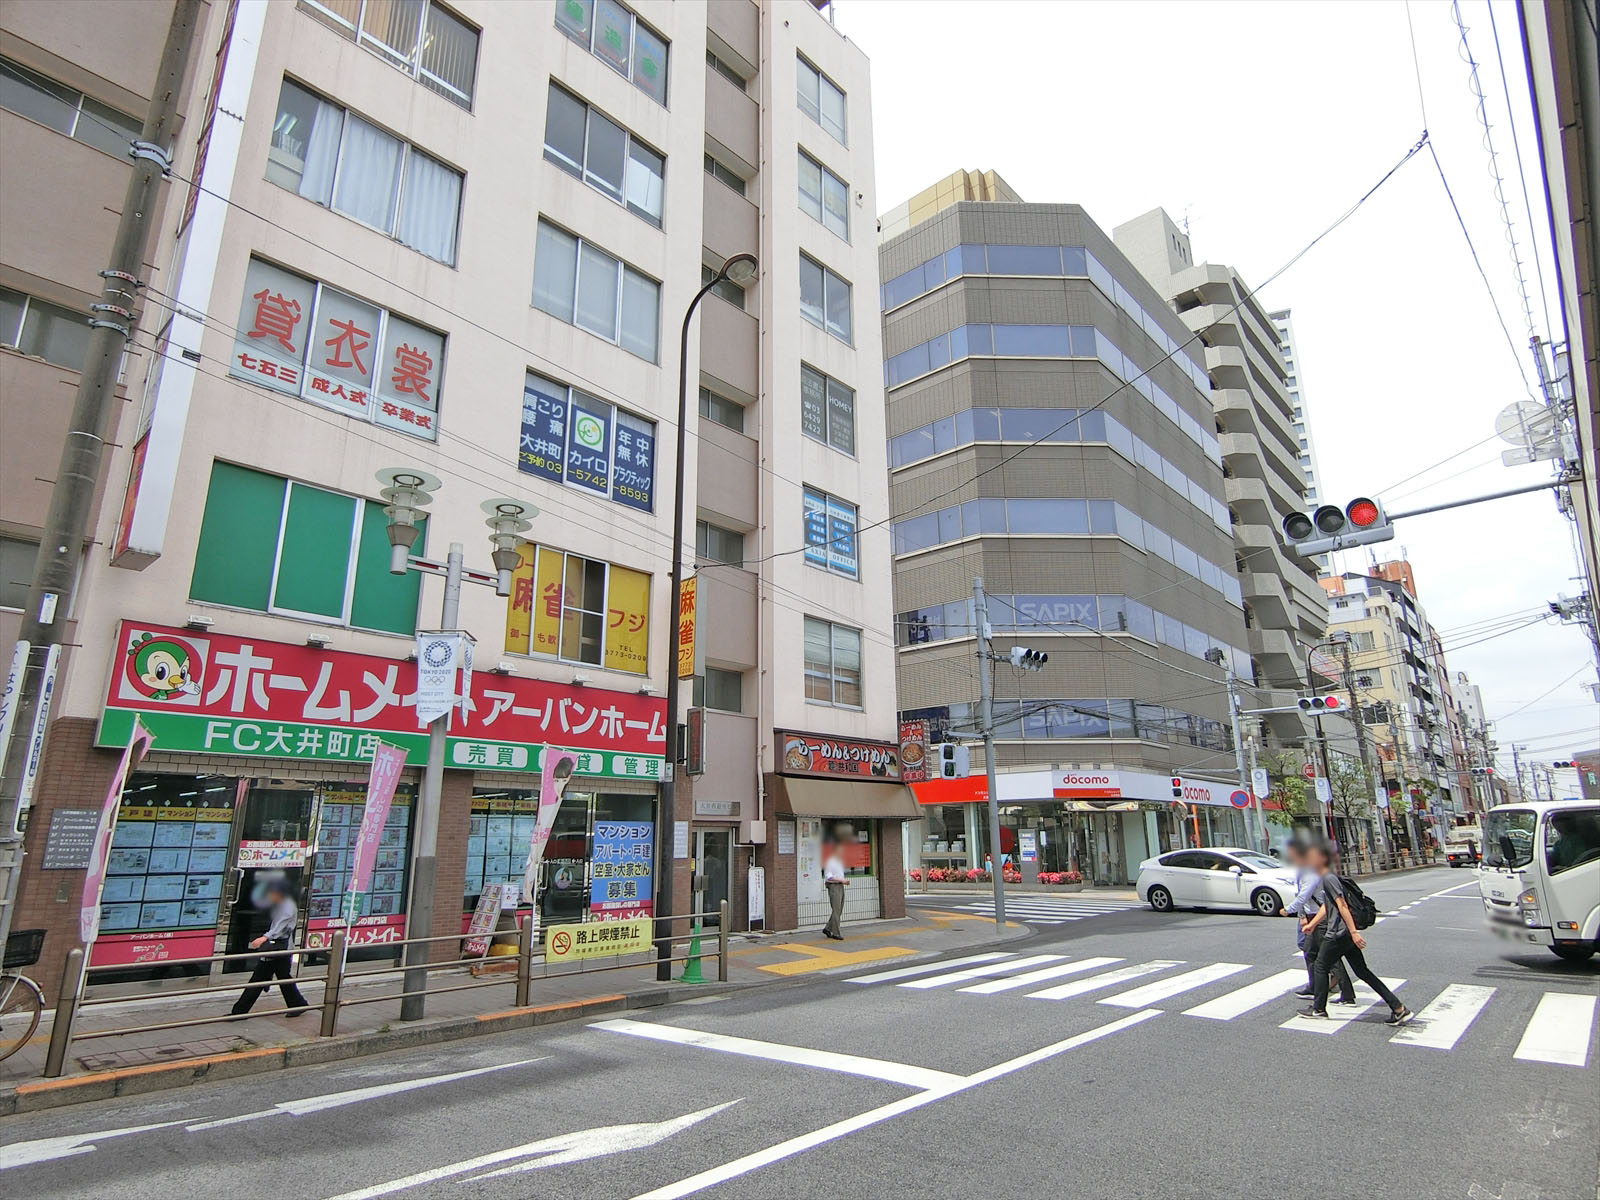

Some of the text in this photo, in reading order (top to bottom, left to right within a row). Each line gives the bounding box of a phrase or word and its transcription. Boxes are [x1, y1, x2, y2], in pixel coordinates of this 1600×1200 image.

[248, 288, 433, 402] 貸衣裳
[237, 353, 432, 430] 七五三 成人式 卒業式
[523, 392, 564, 419] 肩こり
[829, 395, 852, 413] HOMEY
[804, 421, 821, 434] 7422
[609, 608, 645, 633] フジ
[679, 590, 695, 646] 麻雀
[1019, 602, 1093, 621] SAPIX
[619, 644, 633, 653] TEL
[678, 646, 693, 663] フジ
[206, 644, 667, 742] ホームメ アーバンホーム
[1029, 707, 1103, 728] SAPIX
[204, 720, 379, 760] FC大井町店
[468, 745, 513, 767] 売買
[576, 754, 591, 772] 貸
[624, 757, 659, 776] 管理
[1063, 774, 1109, 785] docomo
[1184, 786, 1211, 801] ocomo
[598, 825, 651, 840] マンション
[252, 849, 304, 861] ホームメイト
[595, 844, 651, 859] アパート・戸建
[594, 862, 650, 879] 空室・大家さん
[607, 881, 637, 898] 募集
[576, 924, 640, 945] 路上喫煙禁止
